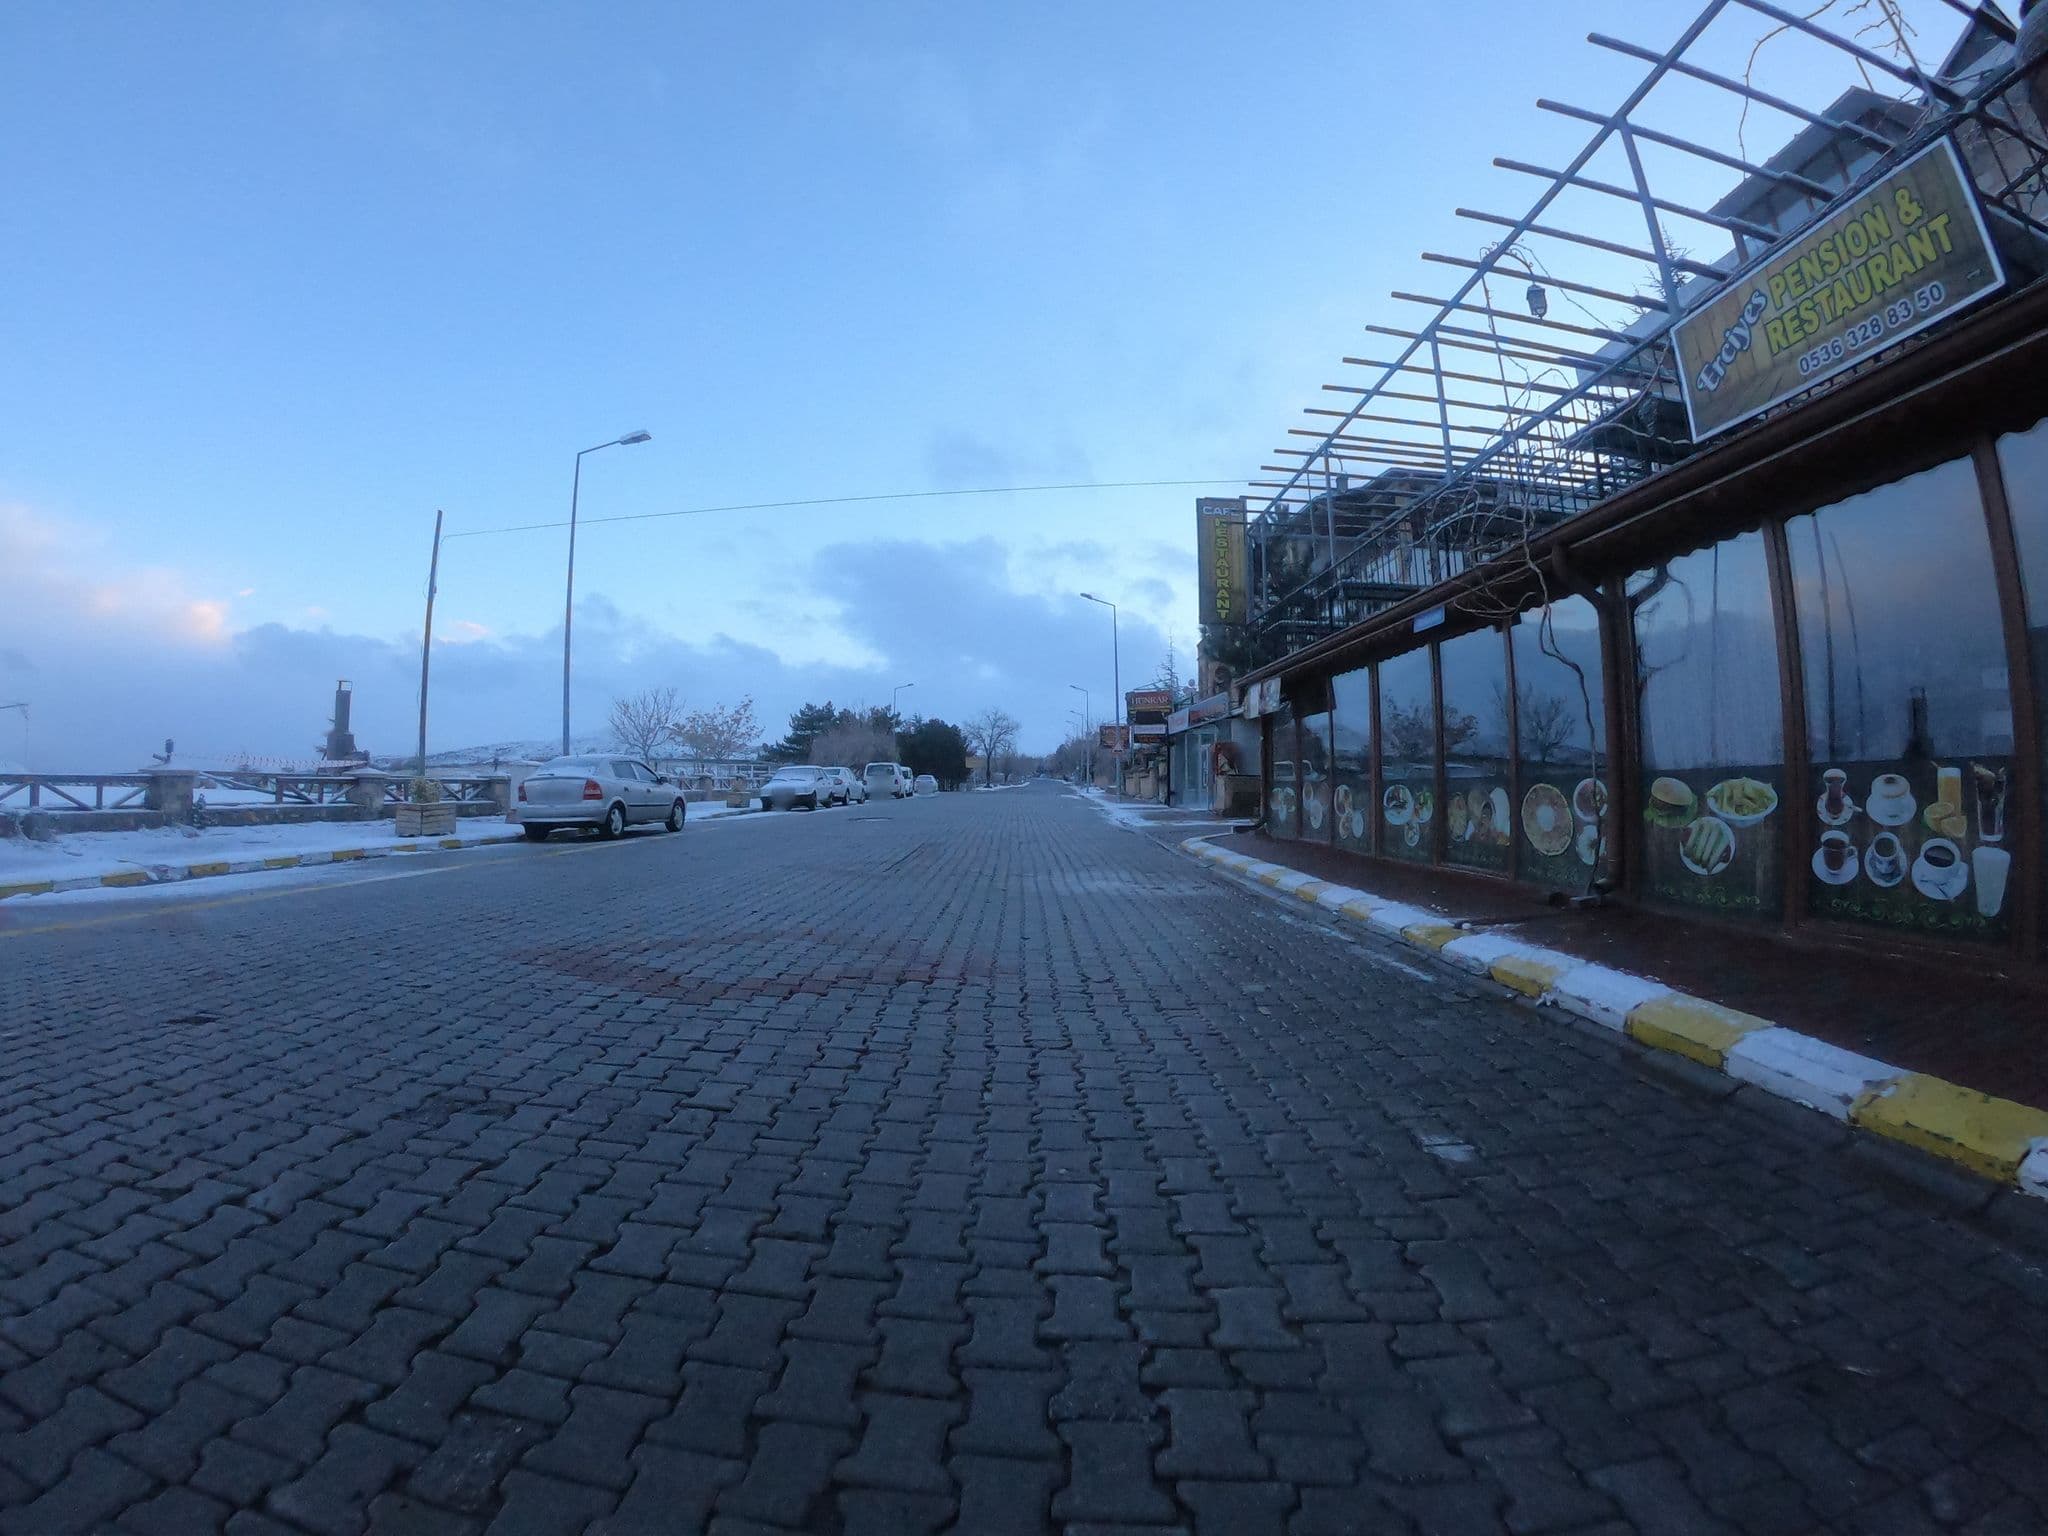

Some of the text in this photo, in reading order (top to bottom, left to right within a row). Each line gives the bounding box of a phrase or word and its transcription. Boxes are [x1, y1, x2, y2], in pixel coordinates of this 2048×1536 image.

[1764, 214, 1952, 354] RESTAURANT
[1768, 188, 1923, 307] PENSION &
[1696, 289, 1767, 392] Erciyes
[1798, 282, 1945, 375] 0536 328 83 50
[1215, 517, 1230, 619] RESTAURANT
